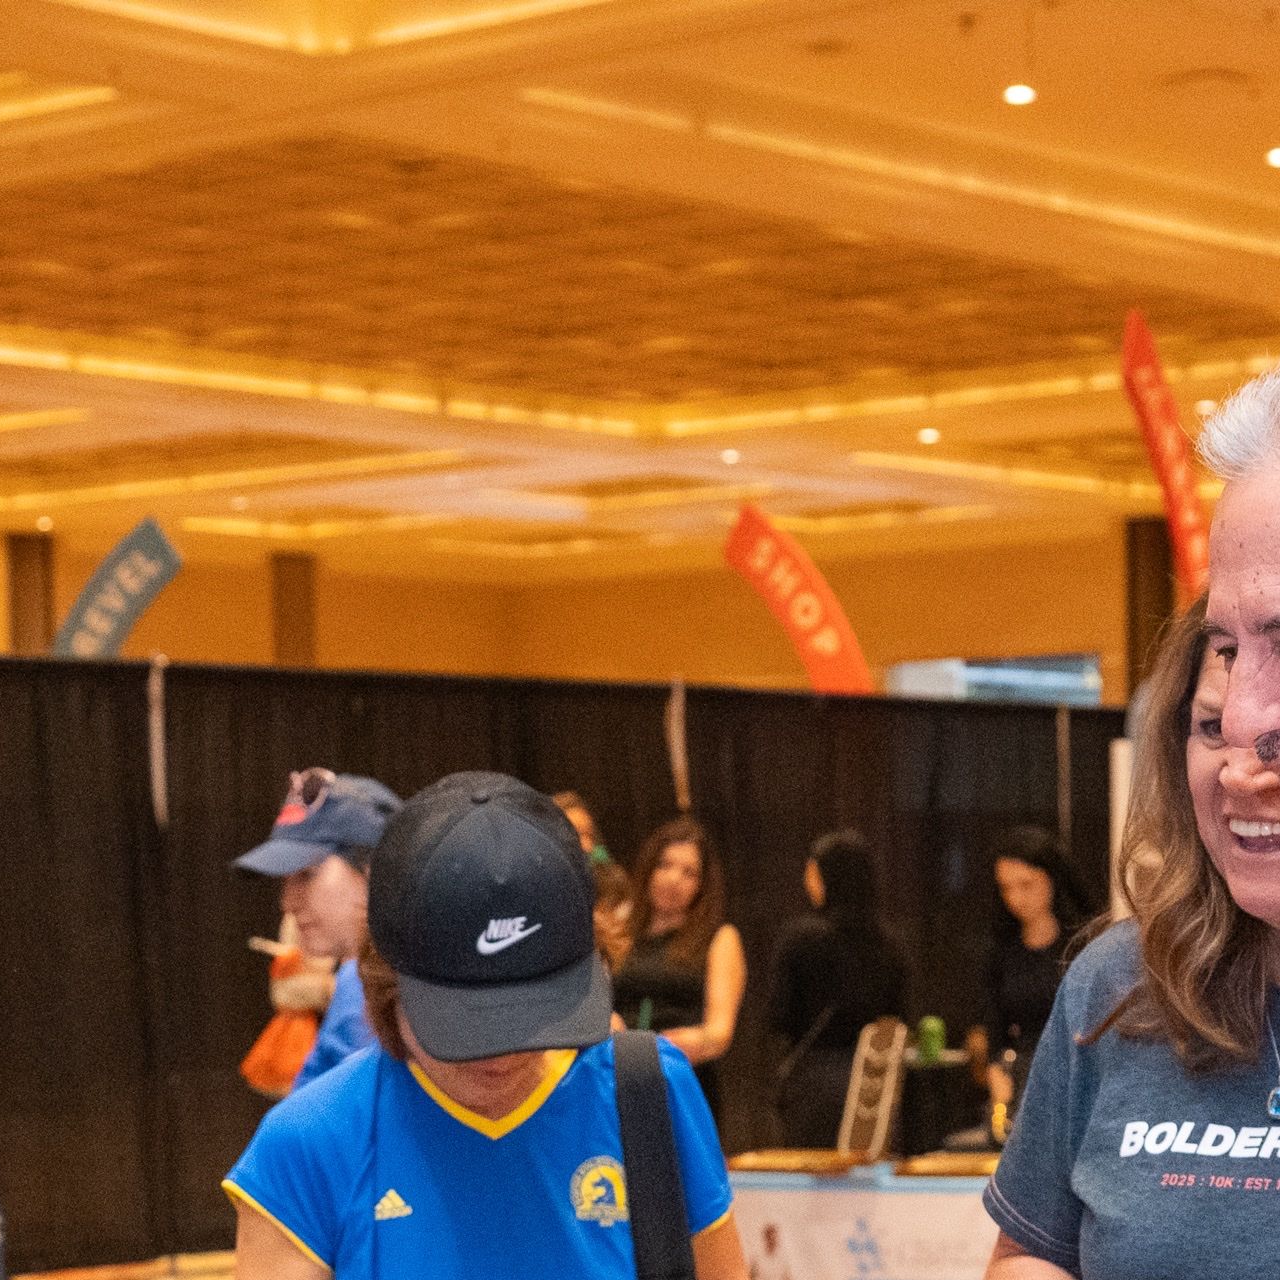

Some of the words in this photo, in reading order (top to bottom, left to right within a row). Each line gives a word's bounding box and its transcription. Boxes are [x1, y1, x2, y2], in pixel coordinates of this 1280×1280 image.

[70, 551, 163, 657] REVEL
[749, 537, 841, 655] SHOP
[486, 916, 527, 940] NIKE
[1160, 1173, 1195, 1187] 2025
[1209, 1175, 1233, 1188] 10K
[1243, 1177, 1272, 1190] EST
